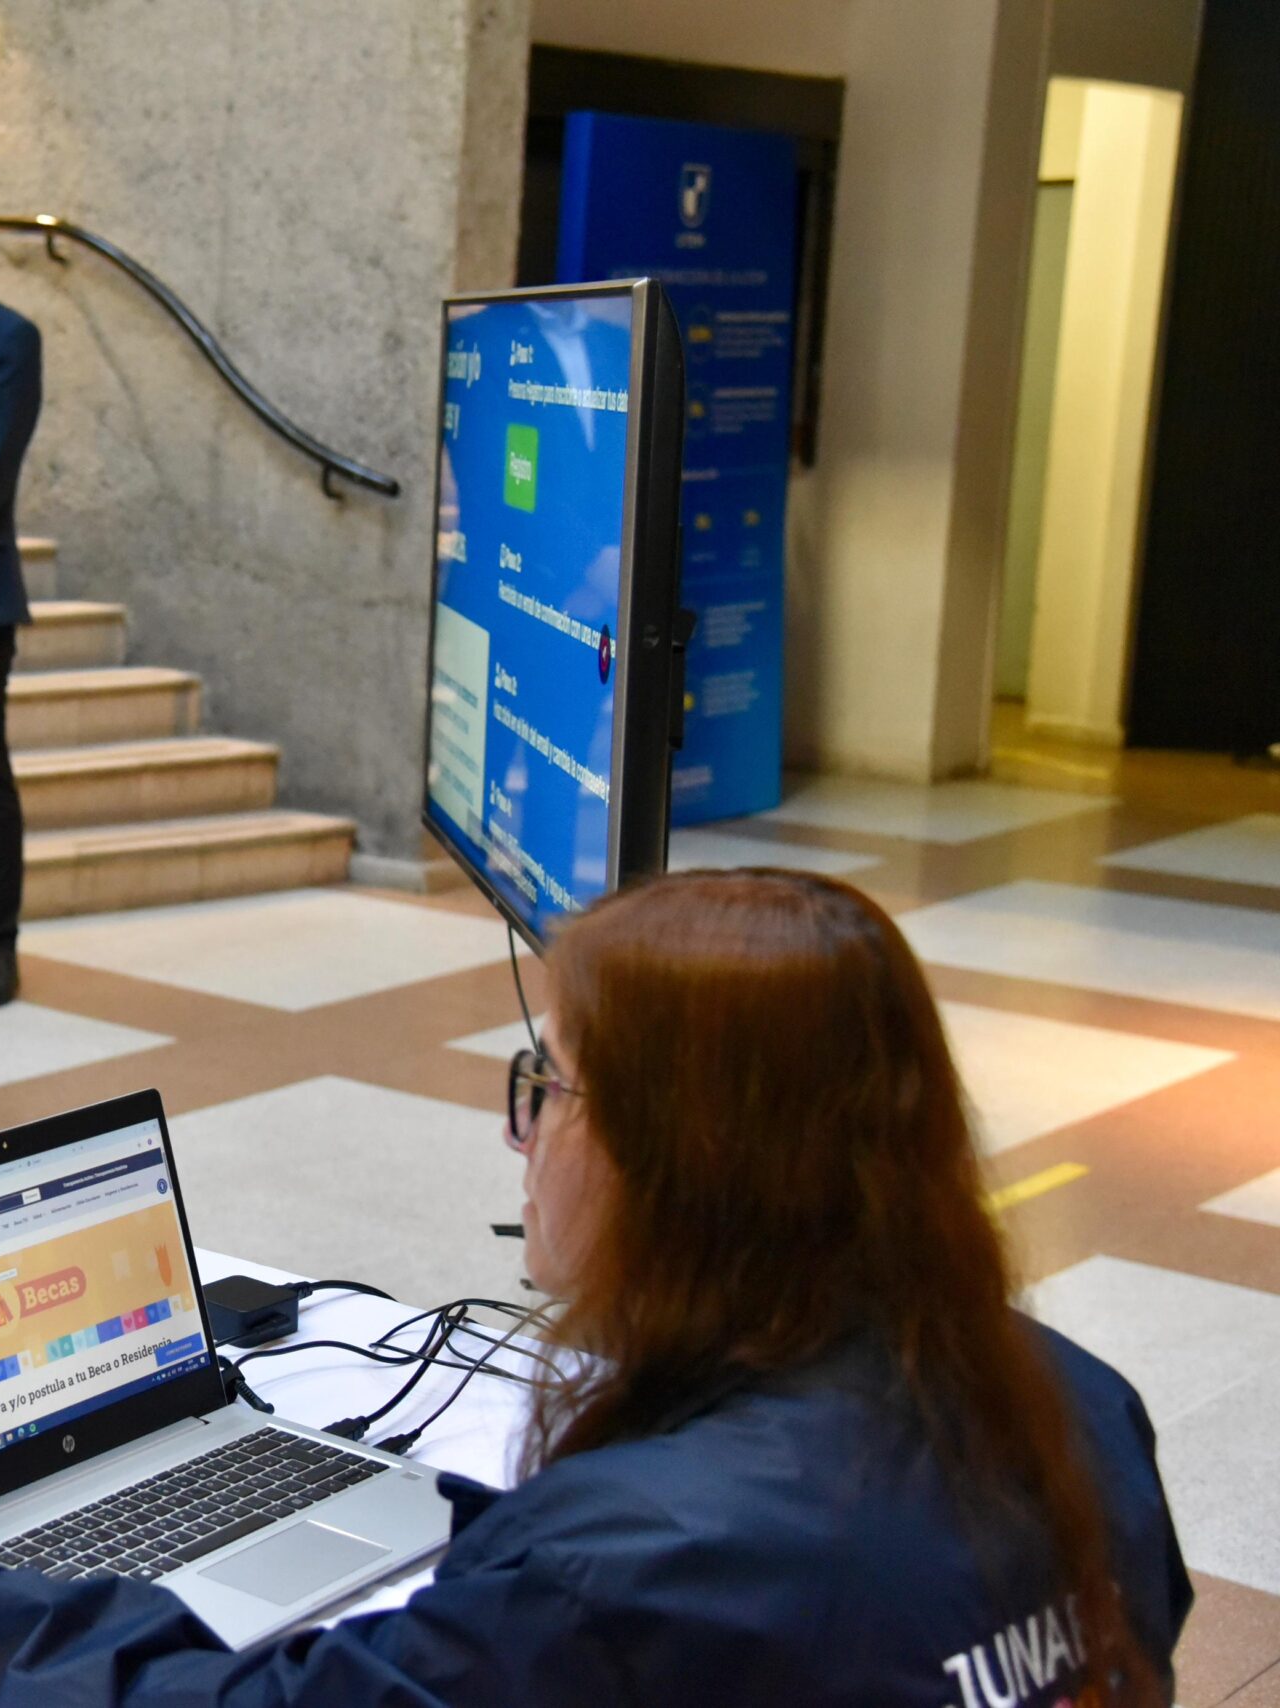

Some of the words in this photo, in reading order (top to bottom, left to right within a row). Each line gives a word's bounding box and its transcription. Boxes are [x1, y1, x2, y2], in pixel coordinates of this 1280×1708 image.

[22, 1277, 80, 1309] Becas
[9, 1394, 27, 1412] y/o
[28, 1379, 66, 1405] postula
[68, 1376, 74, 1387] a
[75, 1371, 87, 1383] tu
[88, 1362, 112, 1379] Beca
[114, 1358, 120, 1369] o
[942, 1592, 1088, 1708] JUNA
